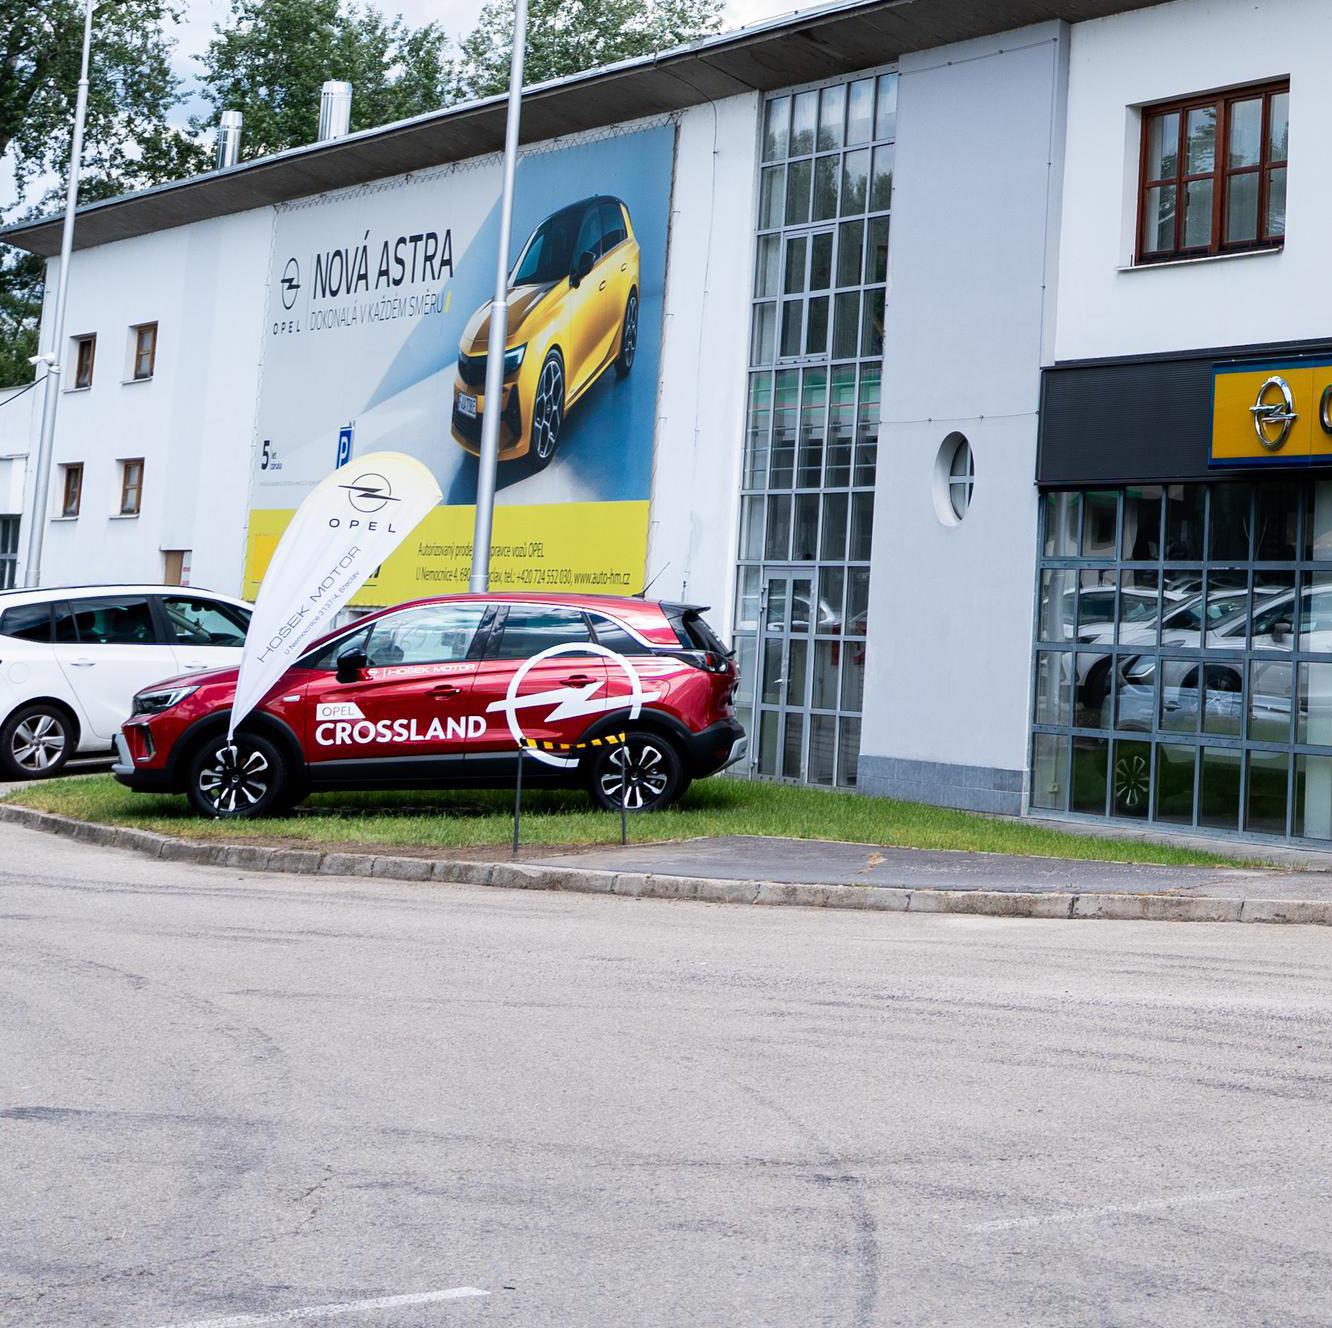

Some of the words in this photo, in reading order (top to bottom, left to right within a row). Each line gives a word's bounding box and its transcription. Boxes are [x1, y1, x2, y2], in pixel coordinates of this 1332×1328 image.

[313, 229, 370, 299] NOVÁ
[375, 229, 453, 290] ASTRA
[310, 300, 357, 331] DOKONALÁ
[360, 305, 367, 325] V
[368, 293, 407, 323] KAŽDÉM
[409, 289, 444, 317] SMĚRU
[273, 320, 300, 335] OPEL
[261, 440, 270, 470] 5
[329, 518, 396, 533] OPEL
[418, 541, 454, 560] Autorizovaný
[528, 542, 544, 558] OPEL
[421, 567, 453, 581] Nemocnice
[574, 568, 631, 585] www.auto-hm.cz
[257, 604, 310, 663] HOŠEK
[310, 546, 361, 604] MOTOR
[322, 705, 355, 718] OPEL
[315, 715, 487, 746] CROSSLAND
